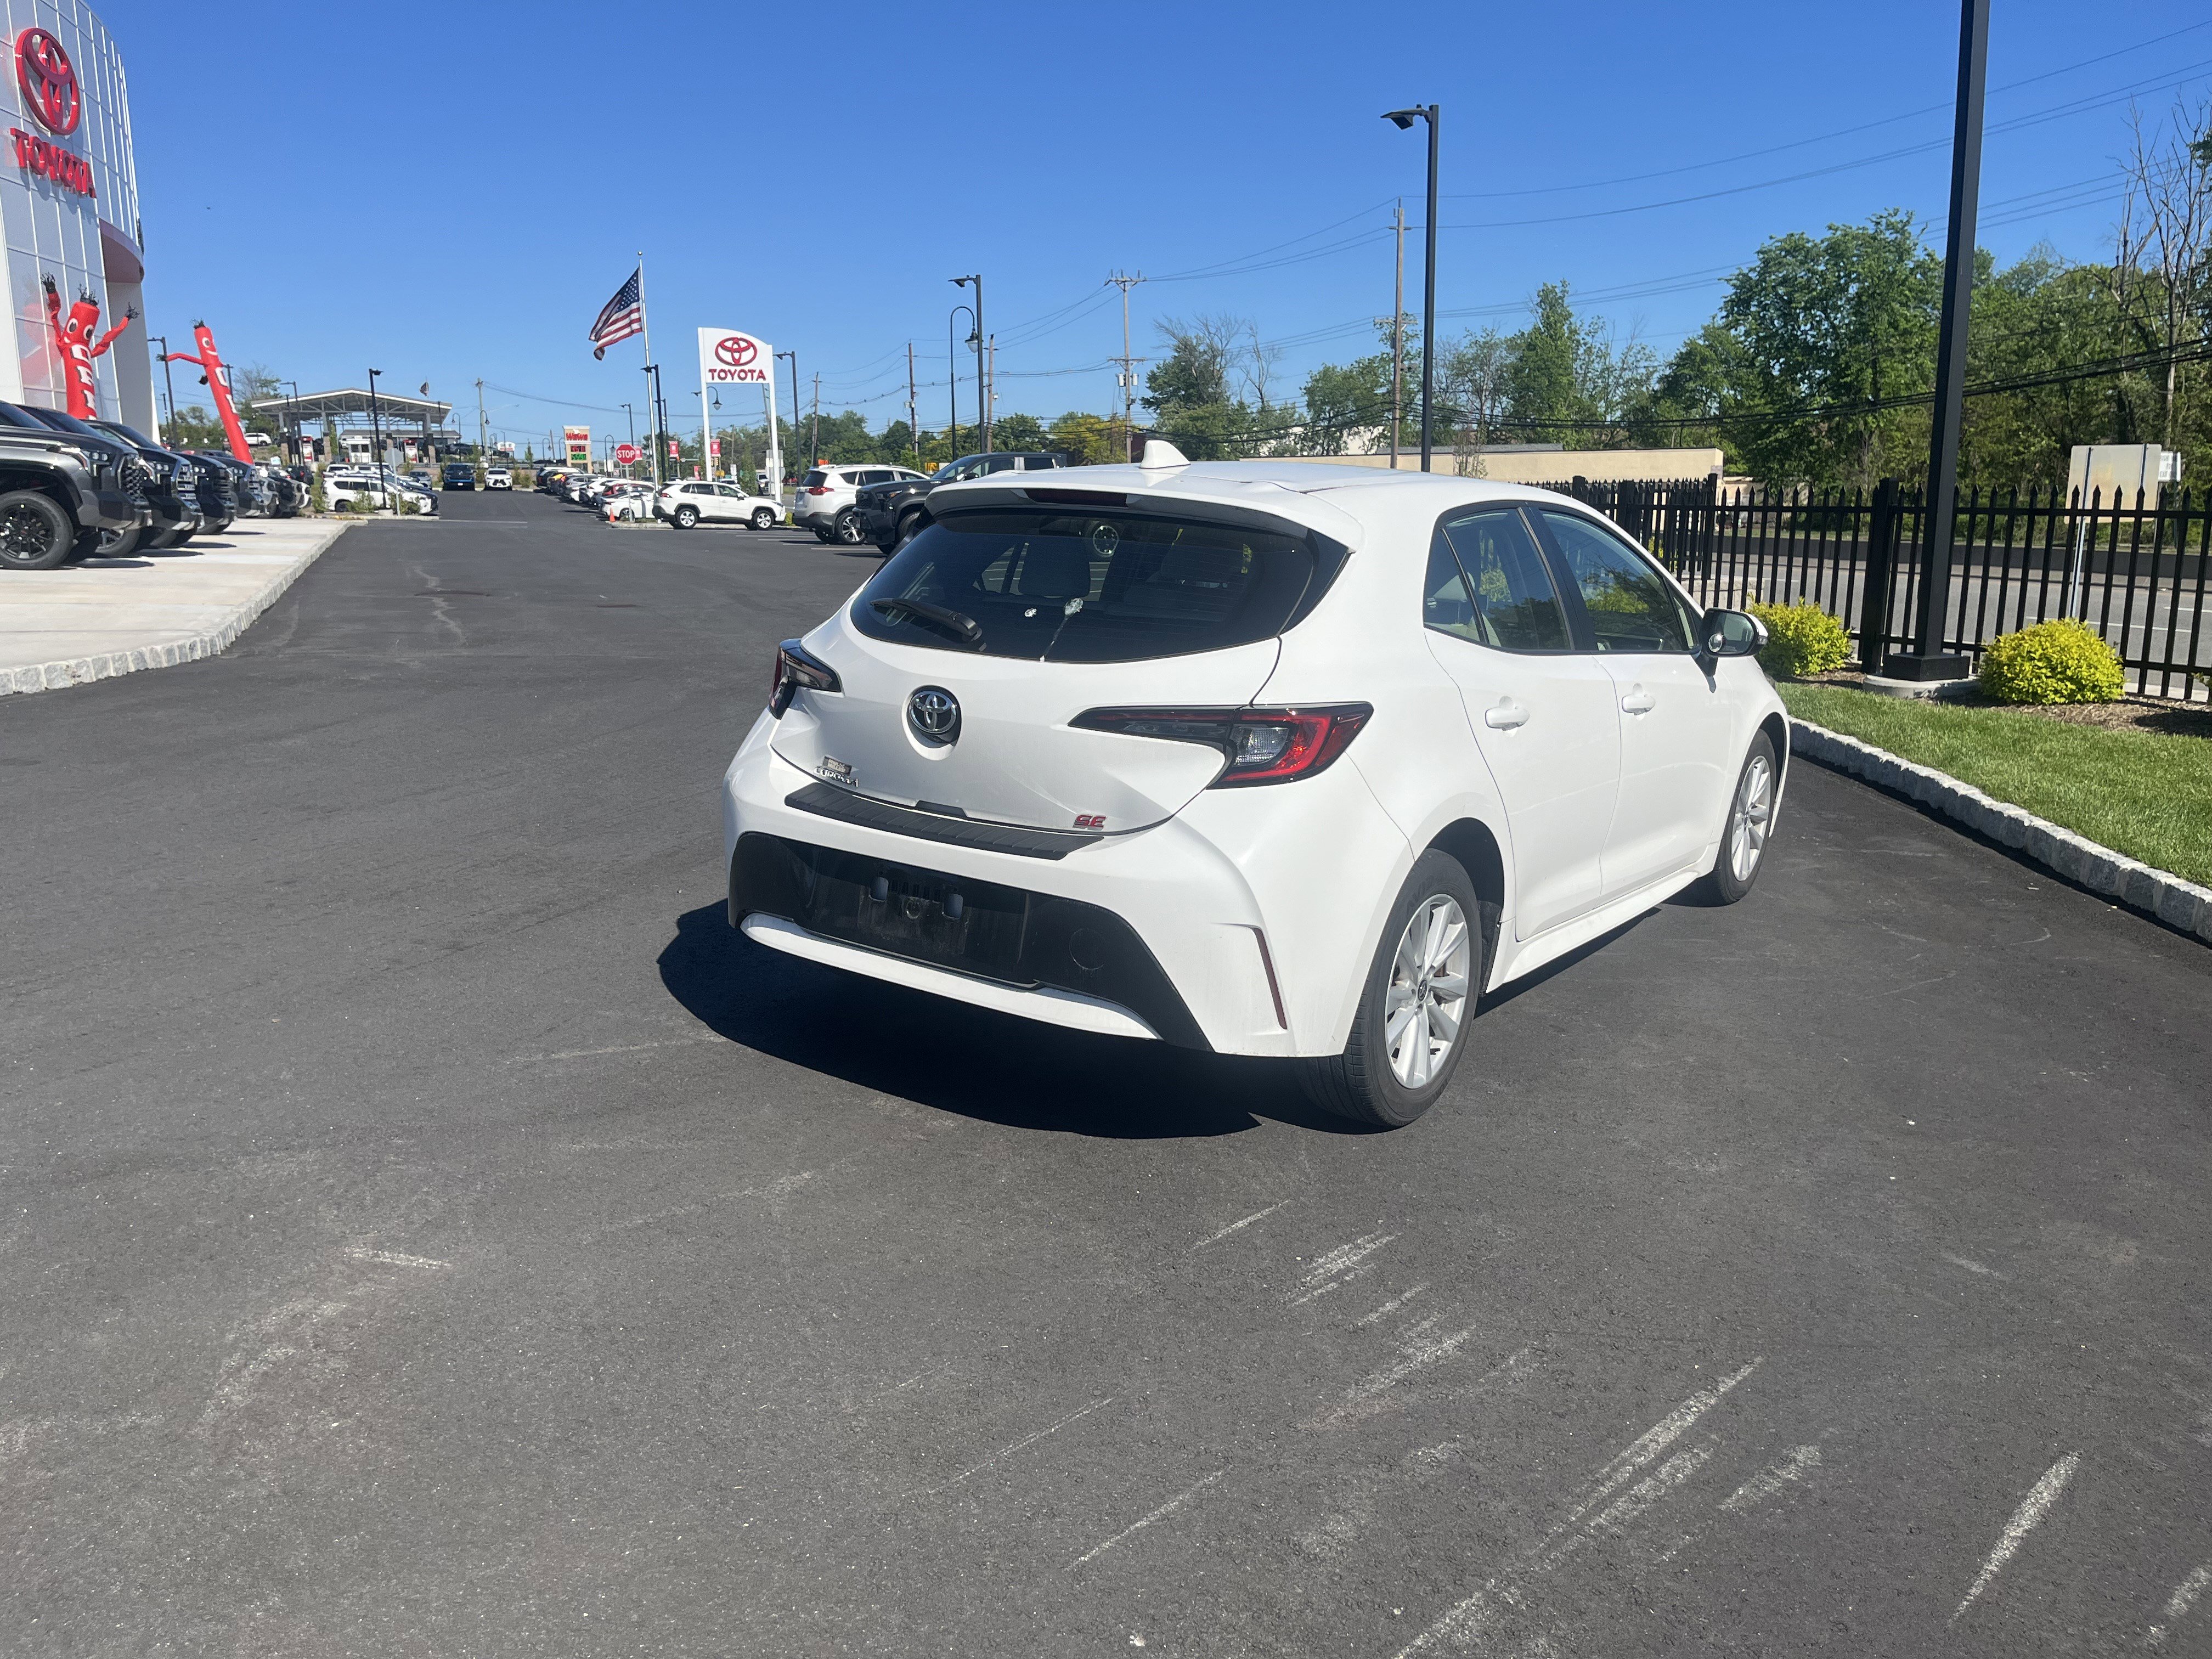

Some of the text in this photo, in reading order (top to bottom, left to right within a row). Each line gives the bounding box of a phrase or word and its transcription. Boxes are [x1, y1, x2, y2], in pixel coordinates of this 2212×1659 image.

[10, 127, 97, 199] TOYOTA
[70, 344, 98, 420] OPE
[708, 369, 766, 381] TOYOTA
[617, 450, 635, 459] STOP
[1073, 814, 1107, 831] SE
